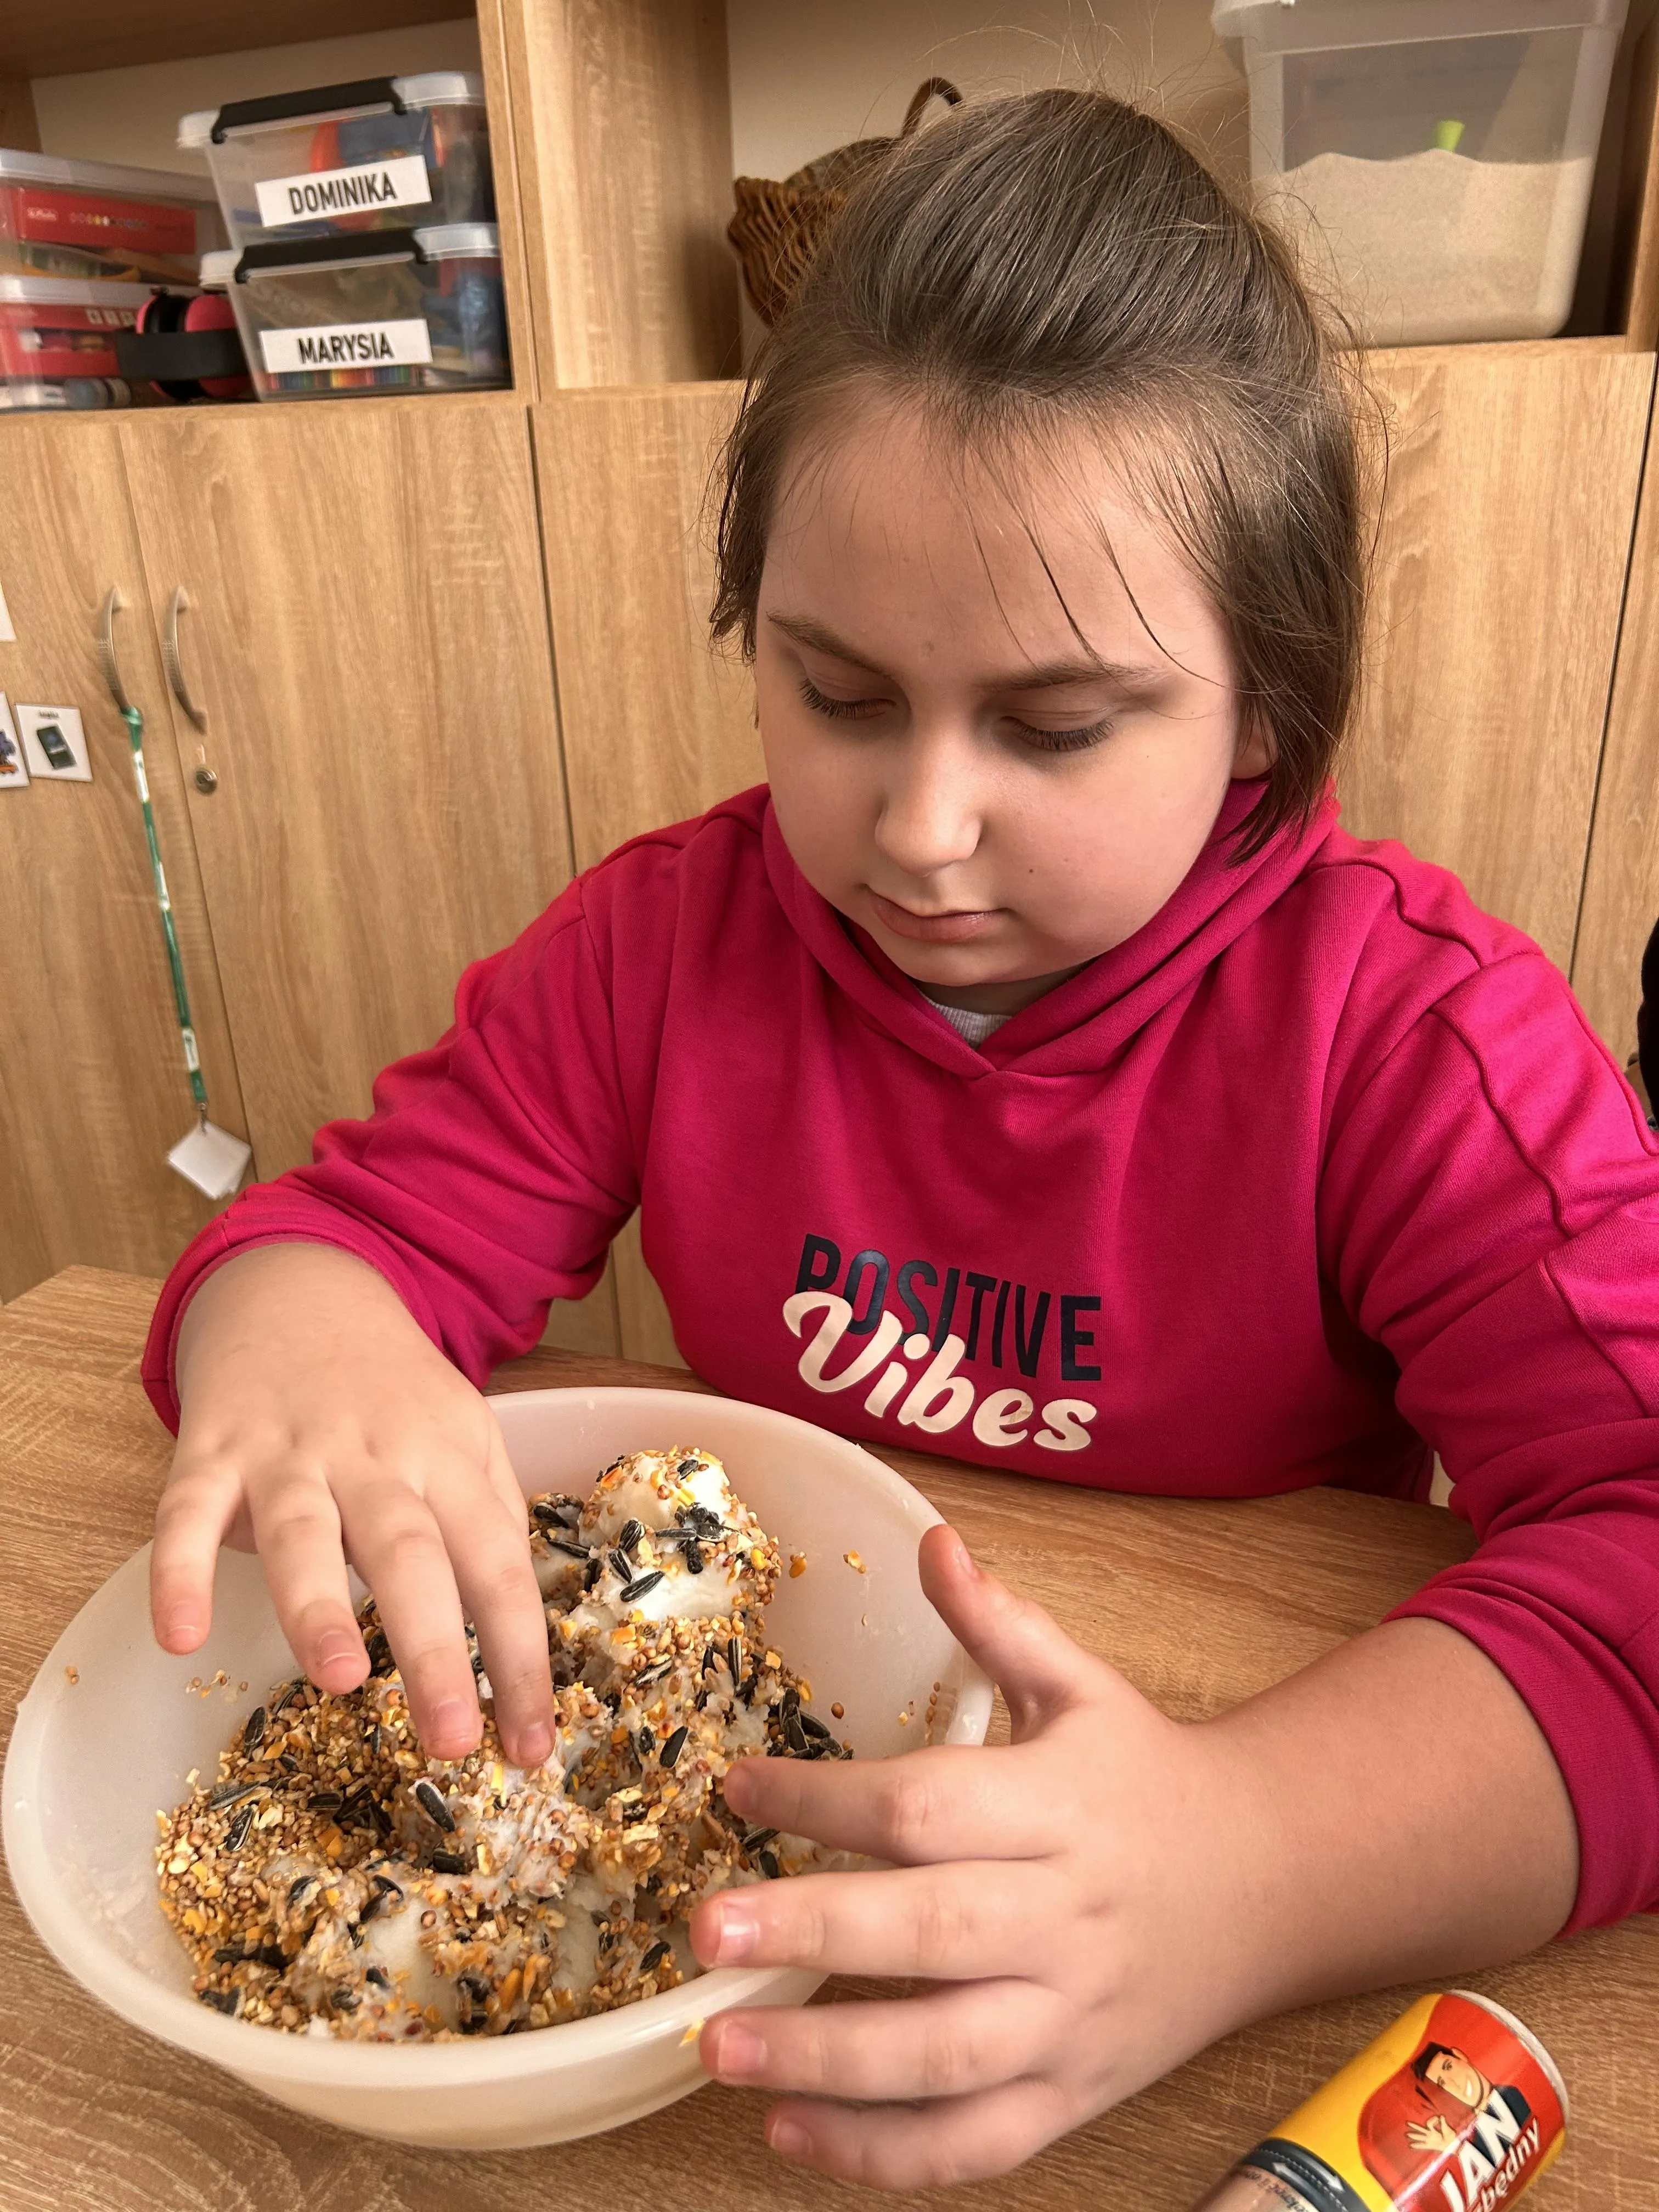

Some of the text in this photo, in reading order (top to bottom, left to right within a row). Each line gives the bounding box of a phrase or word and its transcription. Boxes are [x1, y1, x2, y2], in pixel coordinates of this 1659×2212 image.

[287, 171, 398, 215] DOMINIKA
[297, 331, 396, 365] MARYSIA
[795, 1233, 1102, 1380] POSITIVE
[782, 1291, 1098, 1451] Vibes
[1472, 2115, 1541, 2212] będny
